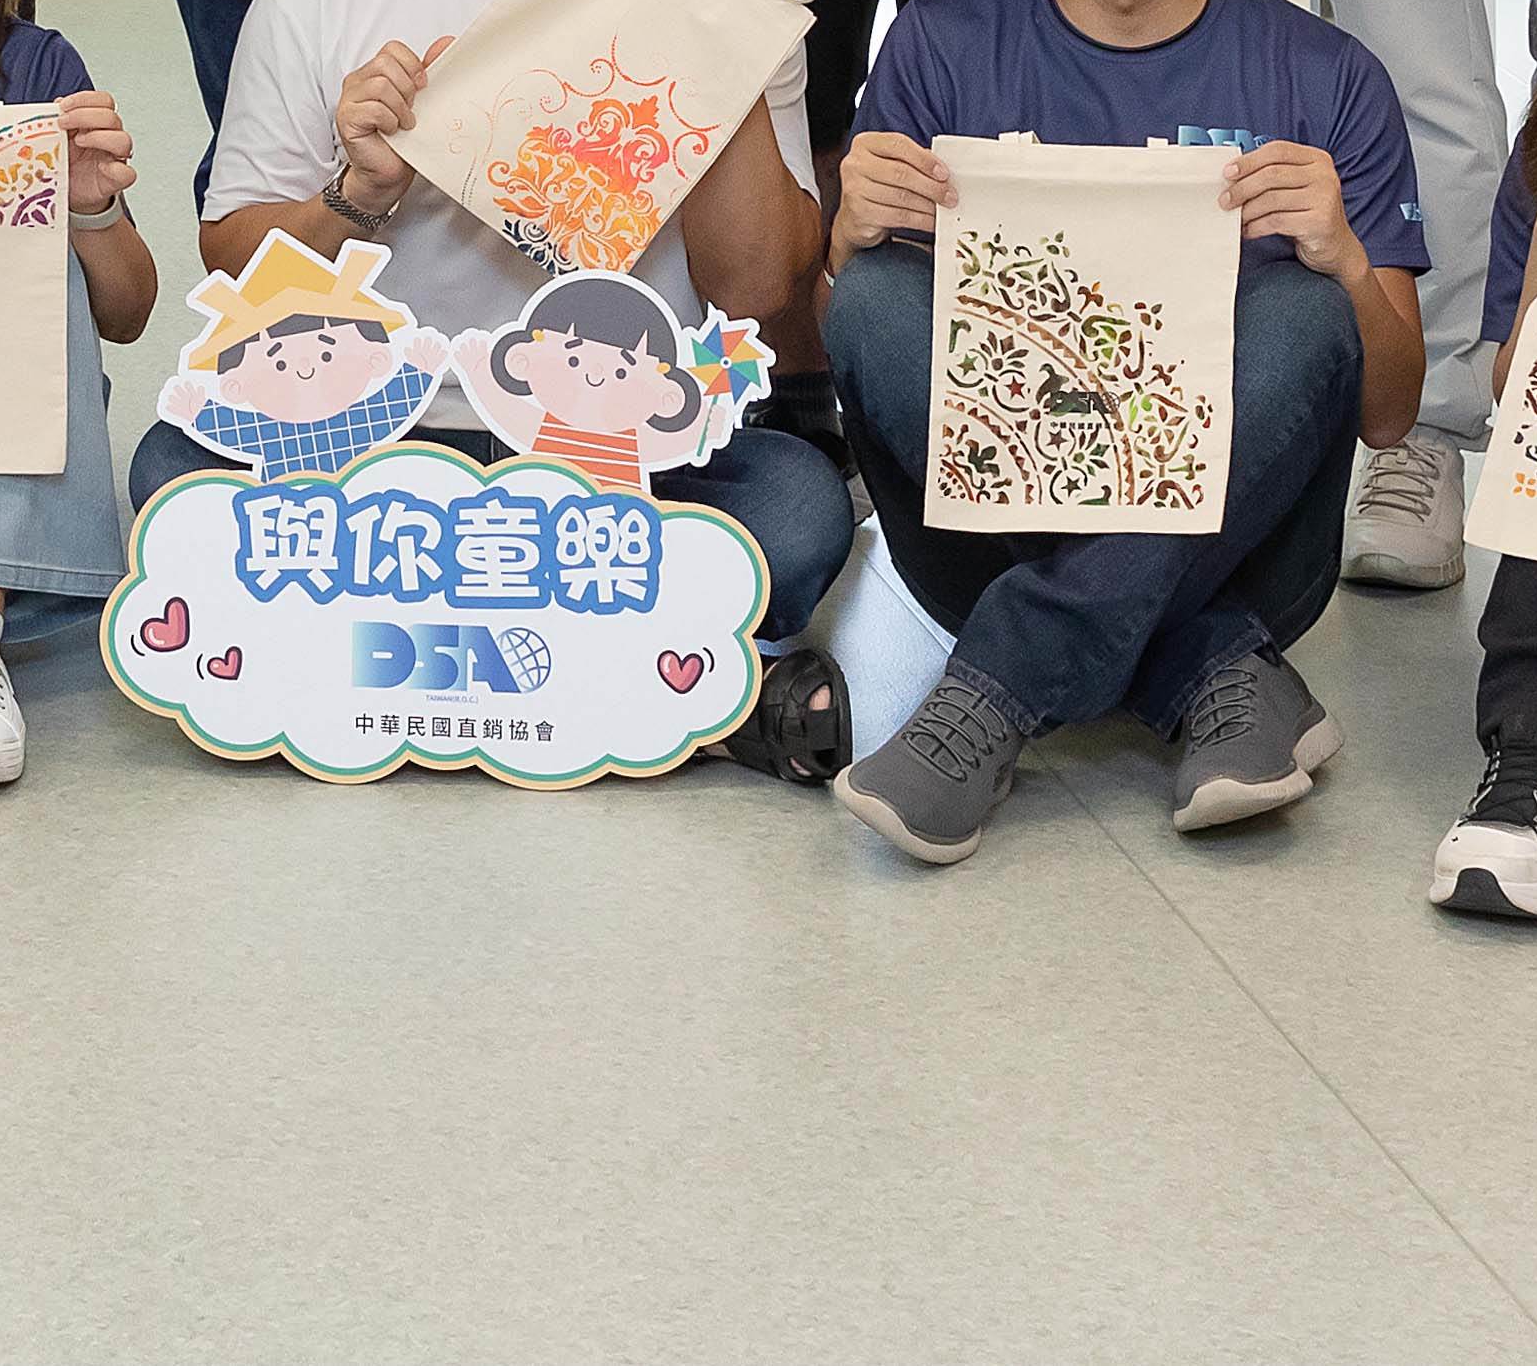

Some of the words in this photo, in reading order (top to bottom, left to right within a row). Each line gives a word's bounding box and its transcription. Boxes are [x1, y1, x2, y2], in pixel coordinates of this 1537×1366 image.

[241, 493, 653, 607] 與你童樂
[351, 621, 522, 694] DSA
[354, 712, 555, 742] 中華民國直銷協會
